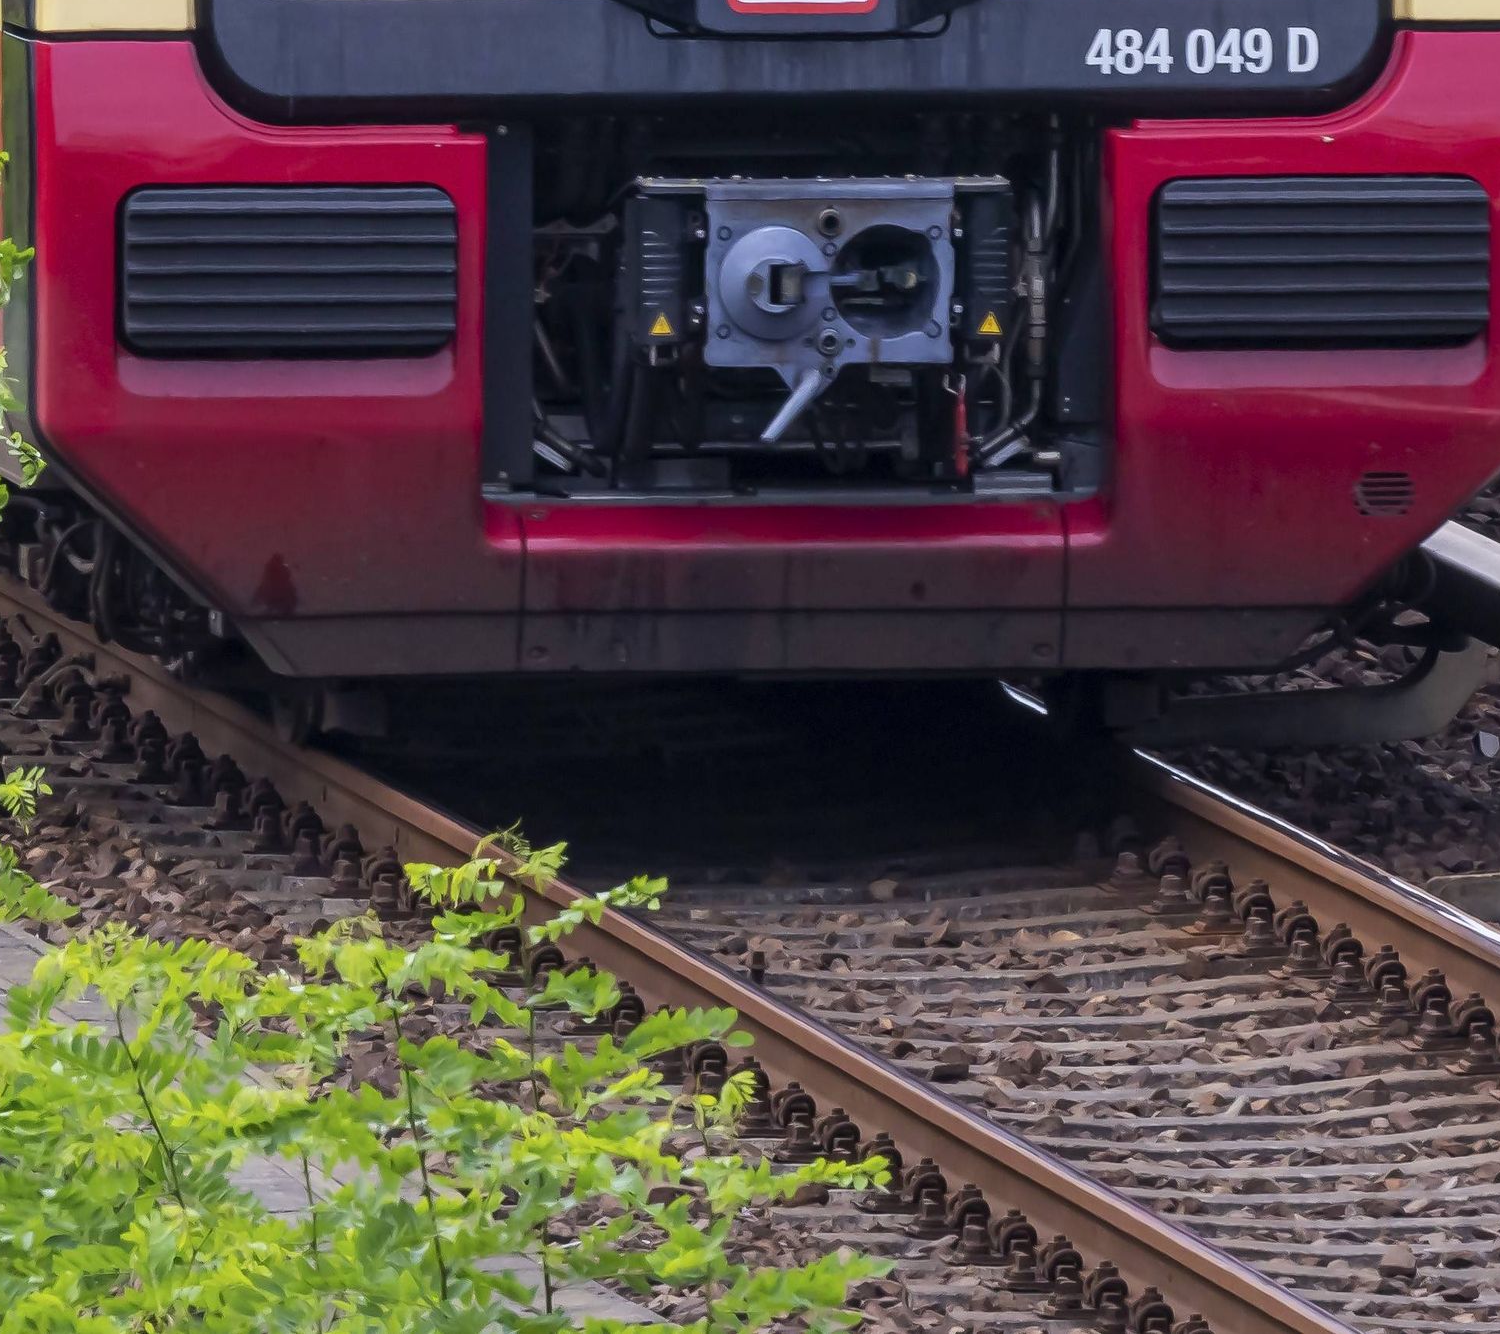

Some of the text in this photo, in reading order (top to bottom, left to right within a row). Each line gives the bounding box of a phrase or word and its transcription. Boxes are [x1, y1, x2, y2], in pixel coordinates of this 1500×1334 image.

[1084, 26, 1320, 75] 484 049 D
